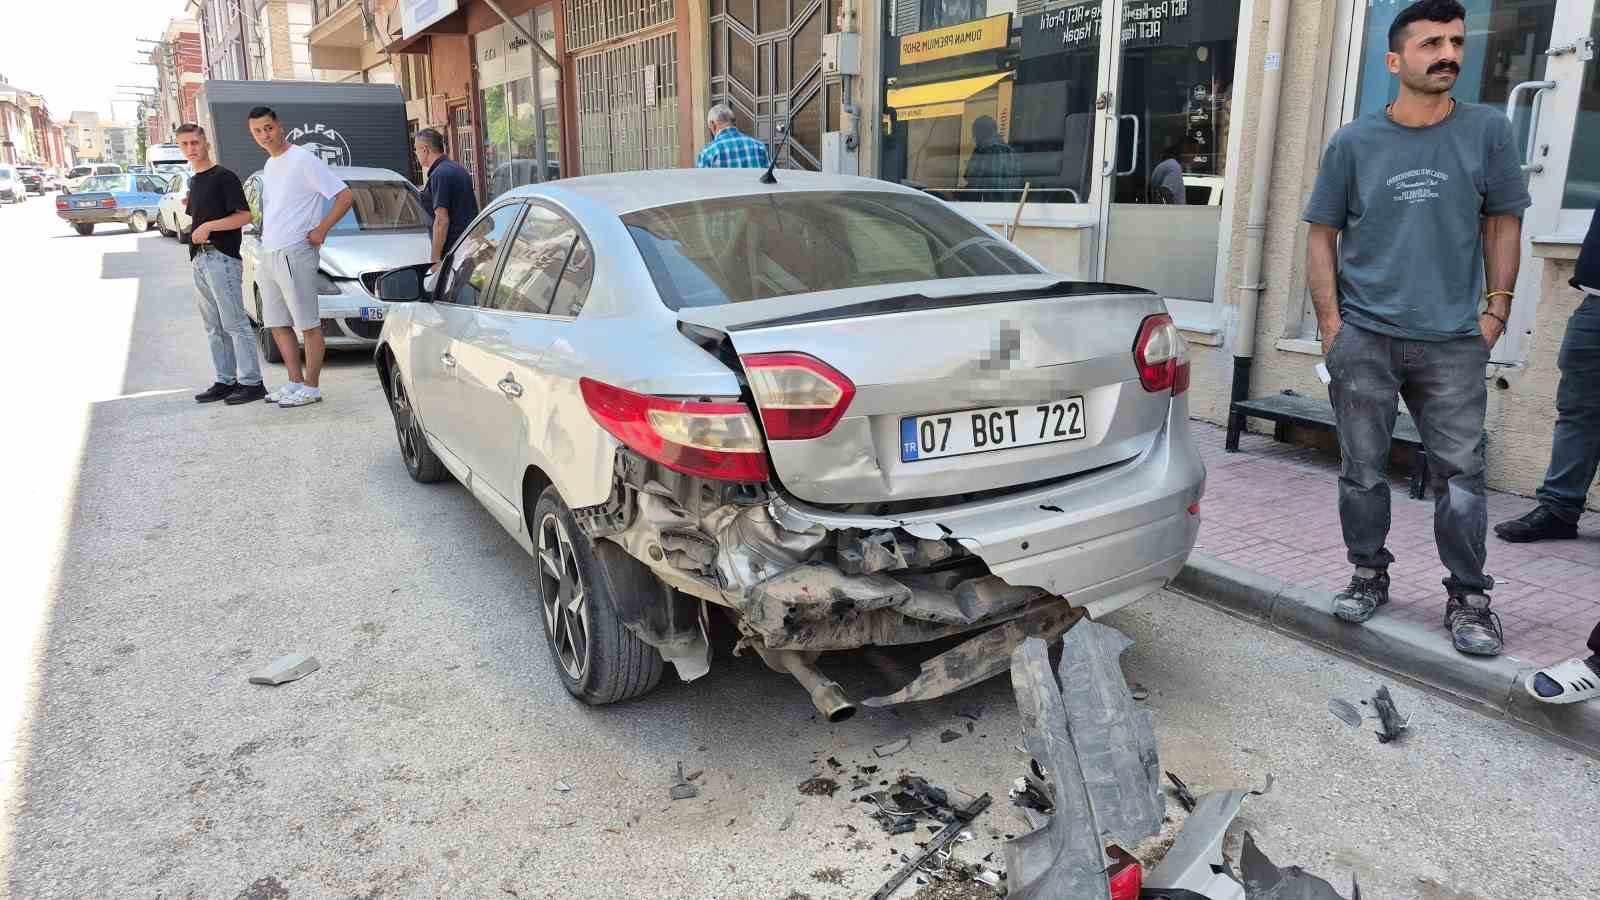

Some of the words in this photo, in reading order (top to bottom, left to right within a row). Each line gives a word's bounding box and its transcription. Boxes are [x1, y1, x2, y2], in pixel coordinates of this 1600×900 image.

[292, 123, 336, 140] ALFA
[920, 418, 952, 453] 07
[971, 409, 1019, 448] BGT
[1036, 402, 1082, 439] 722
[904, 442, 918, 453] TR
